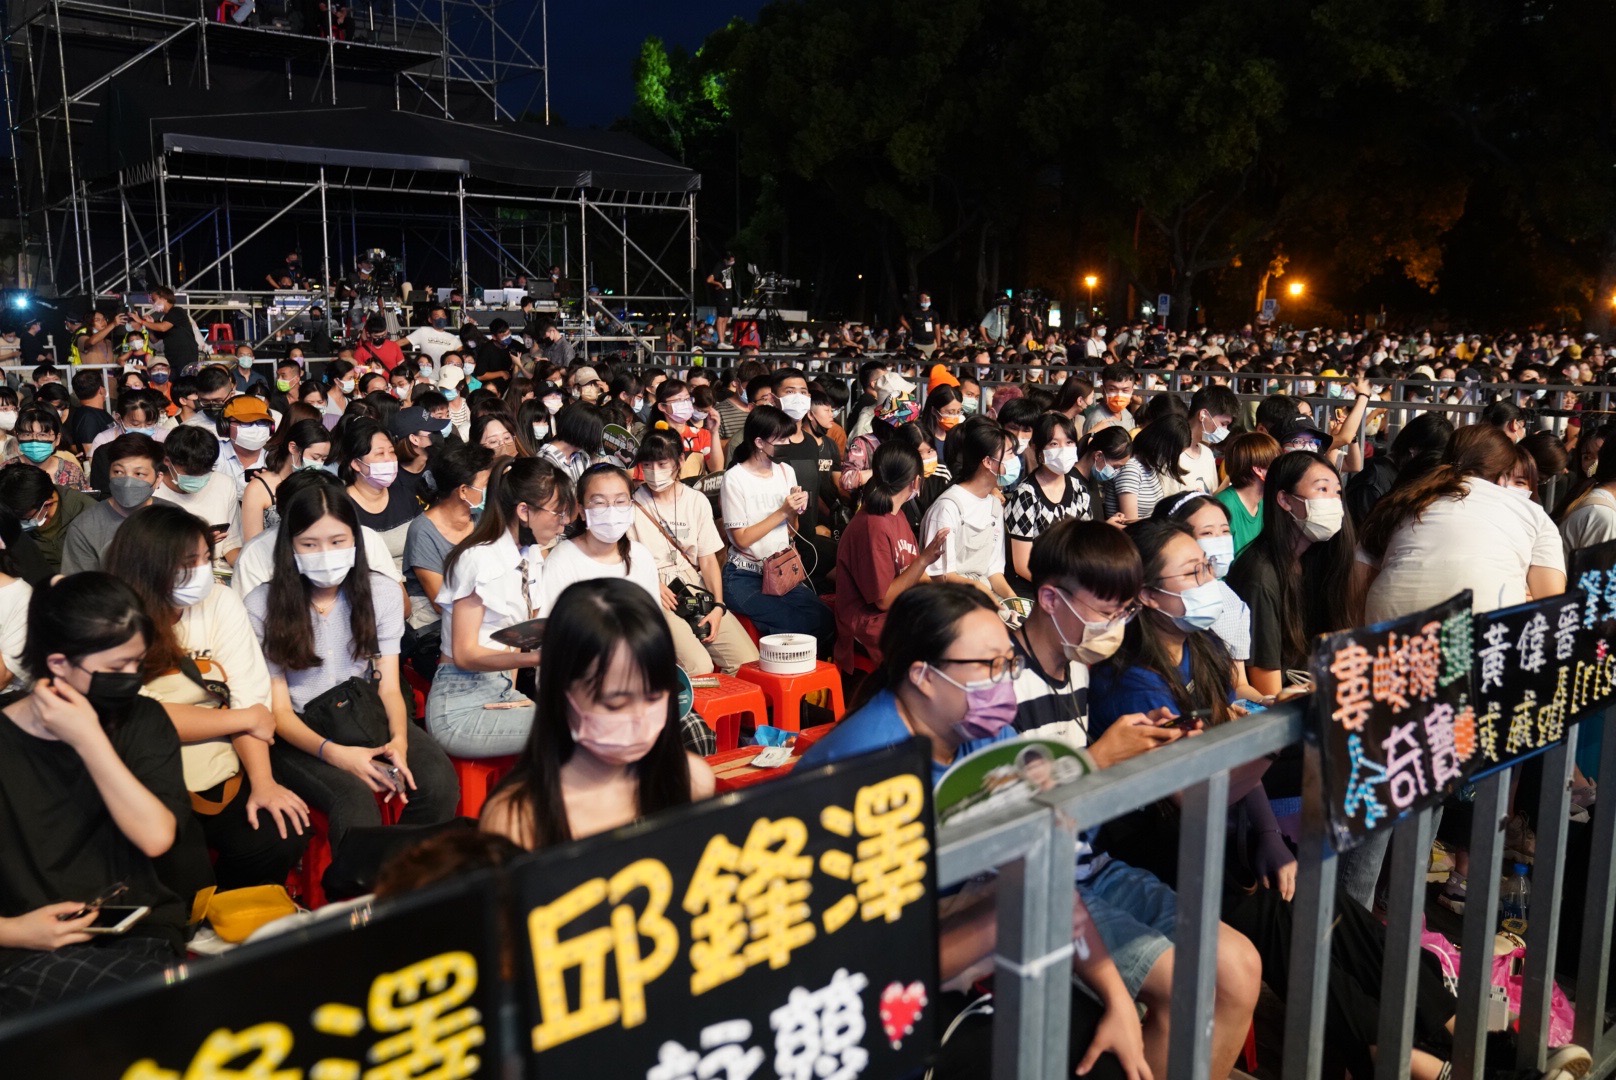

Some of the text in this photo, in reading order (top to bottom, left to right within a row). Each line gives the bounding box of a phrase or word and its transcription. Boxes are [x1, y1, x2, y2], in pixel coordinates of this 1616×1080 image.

[1478, 602, 1580, 693] 黃偉晉
[527, 773, 932, 1053] 邱鋒澤
